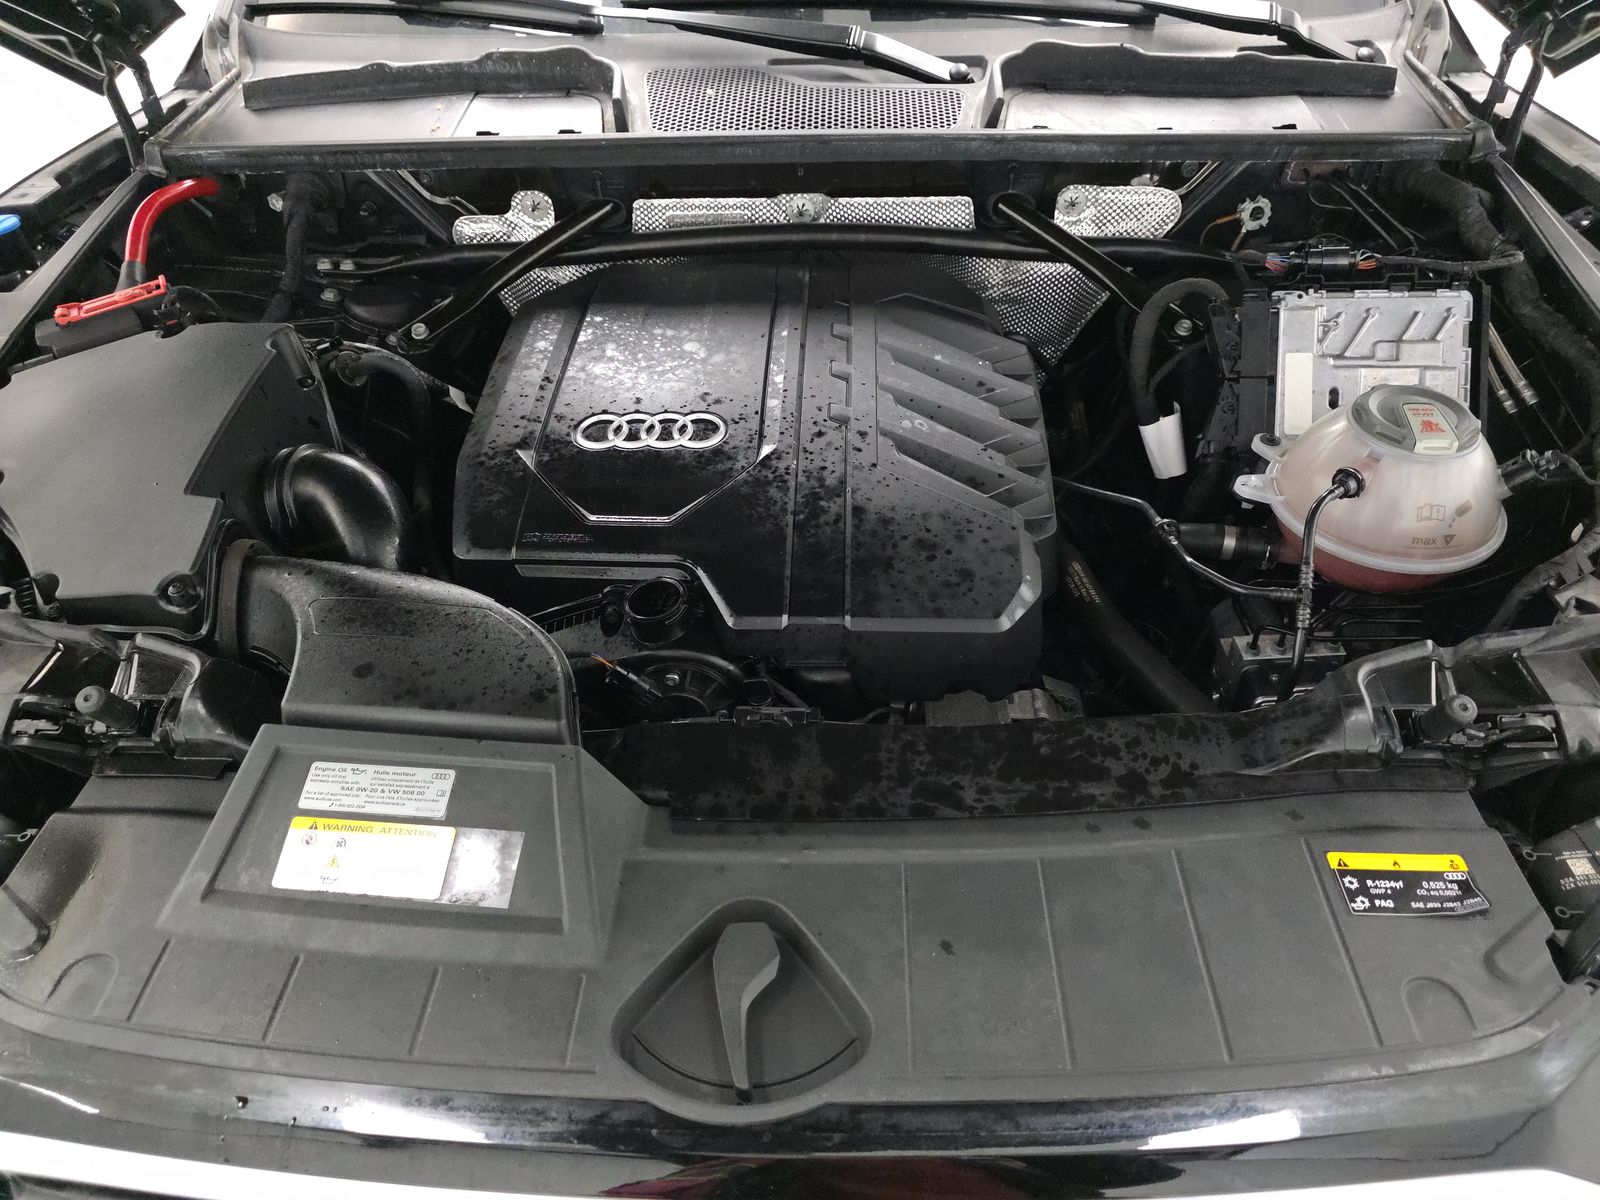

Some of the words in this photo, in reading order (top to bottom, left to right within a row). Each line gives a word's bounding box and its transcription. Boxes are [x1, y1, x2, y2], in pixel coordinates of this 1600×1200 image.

[1411, 537, 1438, 546] max
[314, 765, 336, 773] Engine
[322, 823, 374, 834] WARNING
[379, 826, 438, 838] ATTENTION
[1422, 881, 1446, 890] 0,525
[1446, 881, 1459, 890] kg
[1370, 887, 1386, 895] GWP
[1374, 899, 1395, 908] PAG
